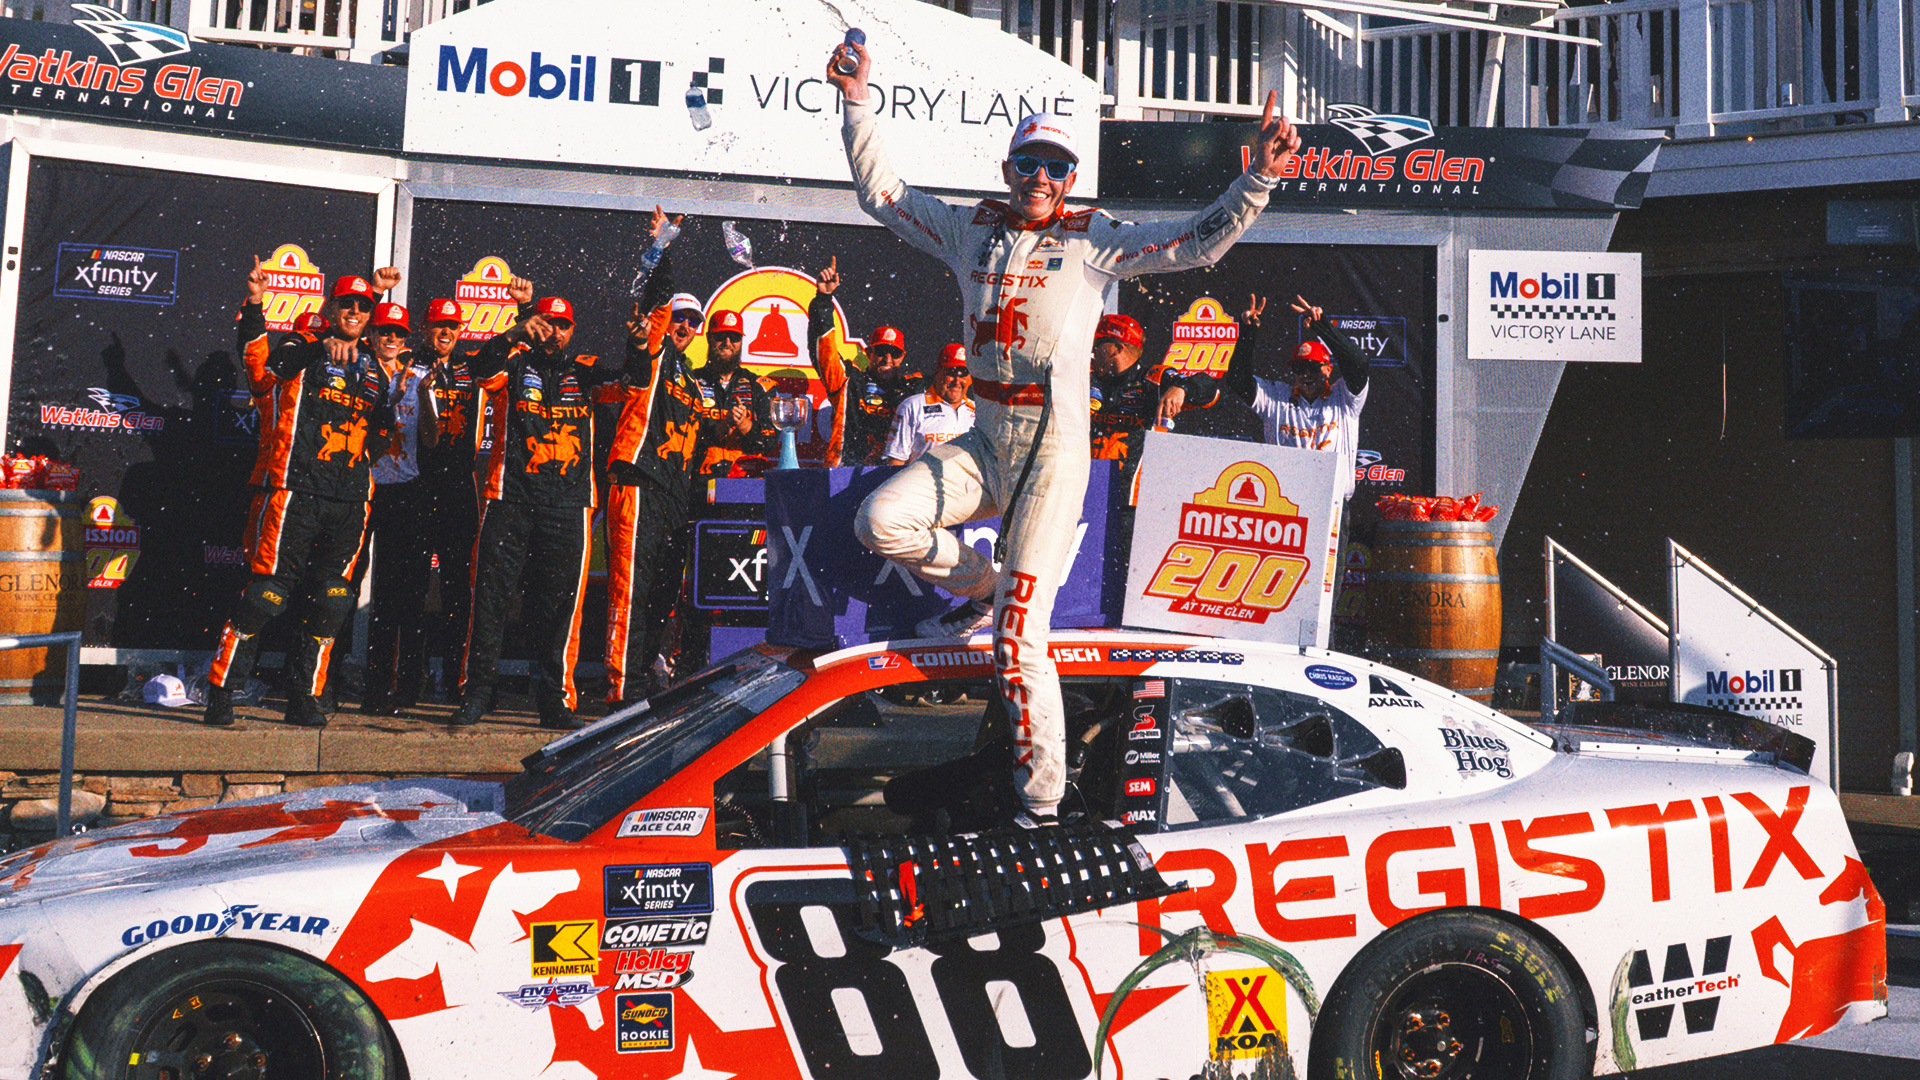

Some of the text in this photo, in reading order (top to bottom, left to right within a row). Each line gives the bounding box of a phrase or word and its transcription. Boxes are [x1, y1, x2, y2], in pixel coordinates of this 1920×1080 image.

[0, 44, 244, 107] atkins Glen
[437, 44, 597, 102] Mobil
[11, 84, 236, 120] TERNATIONAL
[1241, 146, 1485, 182] atkins Glen
[1281, 182, 1480, 194] TERNATIONAL
[103, 250, 145, 263] NASCAR
[74, 260, 158, 292] xfinity
[969, 269, 1049, 289] REGISTIX
[97, 285, 132, 296] SERIES
[459, 285, 511, 300] MISSIO
[1490, 271, 1579, 300] Mobil
[1341, 320, 1377, 330] NASCAR
[1490, 325, 1616, 340] VICTORY LANE
[1163, 343, 1236, 370] 200
[434, 388, 472, 400] GISTIX
[665, 379, 703, 413] REGIS
[41, 405, 165, 430] Watkins Glen
[1368, 465, 1405, 481] Glen
[85, 528, 137, 544] ISSION
[87, 549, 141, 580] 00
[1148, 543, 1308, 609] 200
[1181, 602, 1255, 619] AT THE GLEN
[1053, 648, 1100, 662] ISCH
[994, 570, 1037, 780] REGISTIX
[1606, 665, 1670, 680] GLENOR
[1706, 669, 1775, 695] Mobil
[1368, 697, 1425, 708] AXALTA
[1438, 727, 1510, 752] Blues
[1452, 750, 1513, 779] Hog
[1129, 782, 1151, 793] SEM
[648, 811, 697, 822] NASCAR
[630, 823, 692, 832] RACE CAR
[646, 868, 682, 879] NASCAR
[1138, 787, 1827, 957] REGISTIX
[622, 879, 695, 905] xfinity
[644, 900, 674, 910] SERIES
[604, 921, 708, 944] COMETIC
[533, 964, 596, 976] KENNAMETAL
[616, 948, 693, 975] Holley
[614, 973, 681, 990] MSD
[745, 878, 1094, 1080] 88
[556, 984, 588, 994] STAR
[624, 1009, 666, 1018] SUNOCO
[621, 1030, 669, 1040] ROOKIE
[1216, 1033, 1278, 1052] KOA
